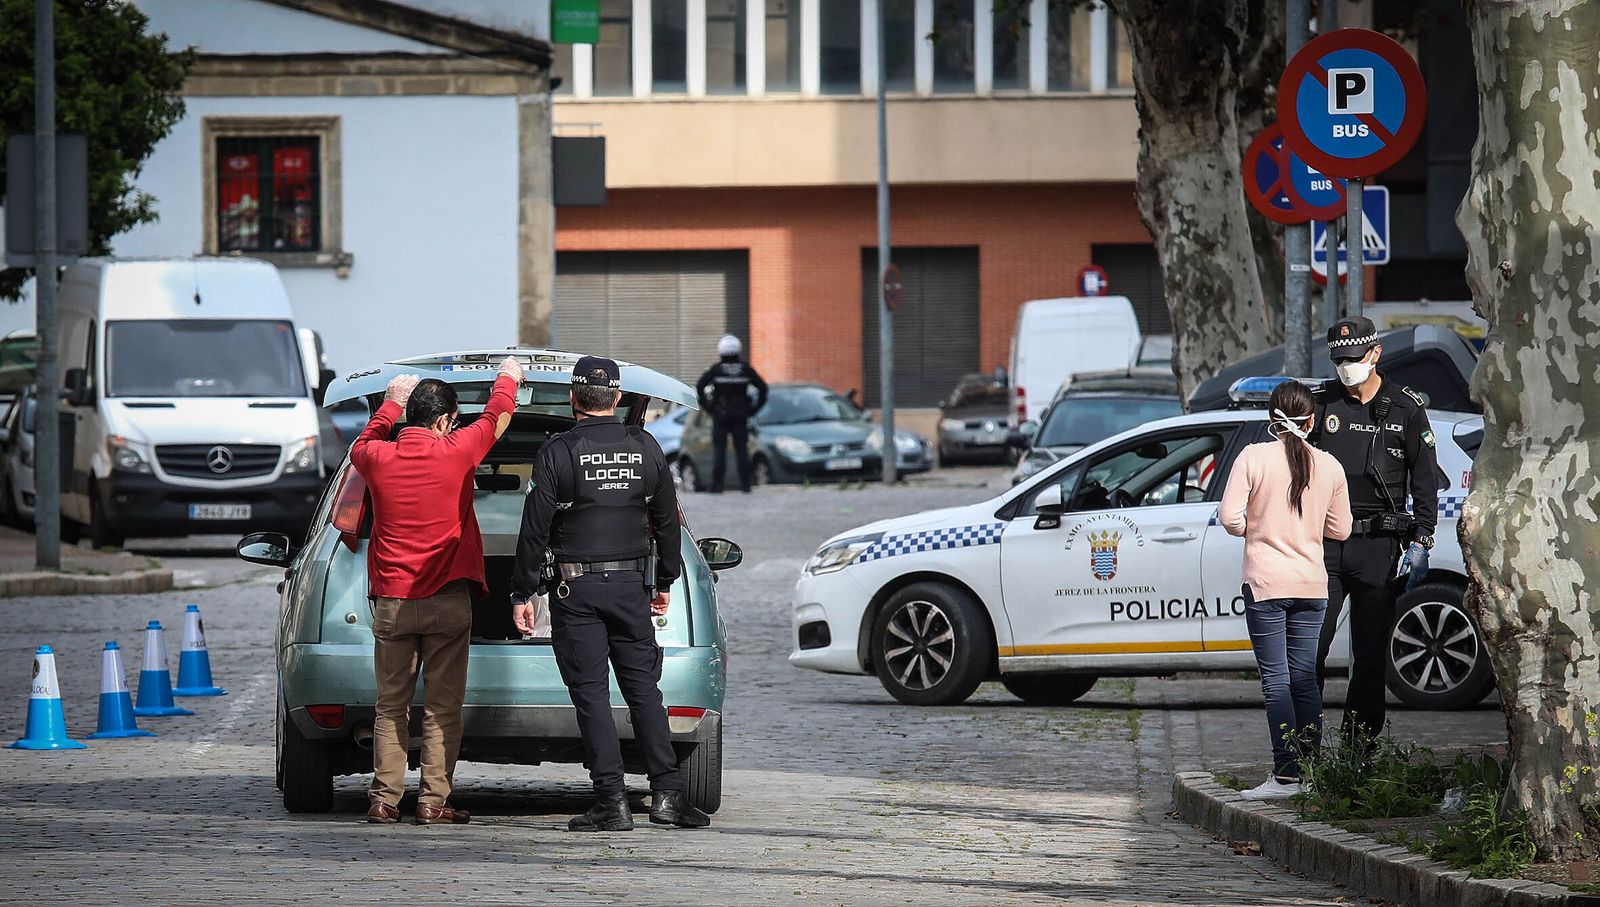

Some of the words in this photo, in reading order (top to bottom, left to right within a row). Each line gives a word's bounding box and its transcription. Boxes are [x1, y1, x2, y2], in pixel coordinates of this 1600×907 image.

[1335, 72, 1367, 110] P
[1332, 124, 1370, 138] BUS
[1310, 180, 1333, 191] BUS
[580, 453, 643, 466] POLICIA
[585, 468, 642, 480] LOCAL
[597, 482, 629, 490] JEREZ
[1054, 588, 1081, 597] JEREZ
[1083, 587, 1094, 596] DE
[1097, 587, 1109, 595] LA
[1110, 585, 1156, 595] FRONTERA
[1110, 597, 1209, 621] POLICIA
